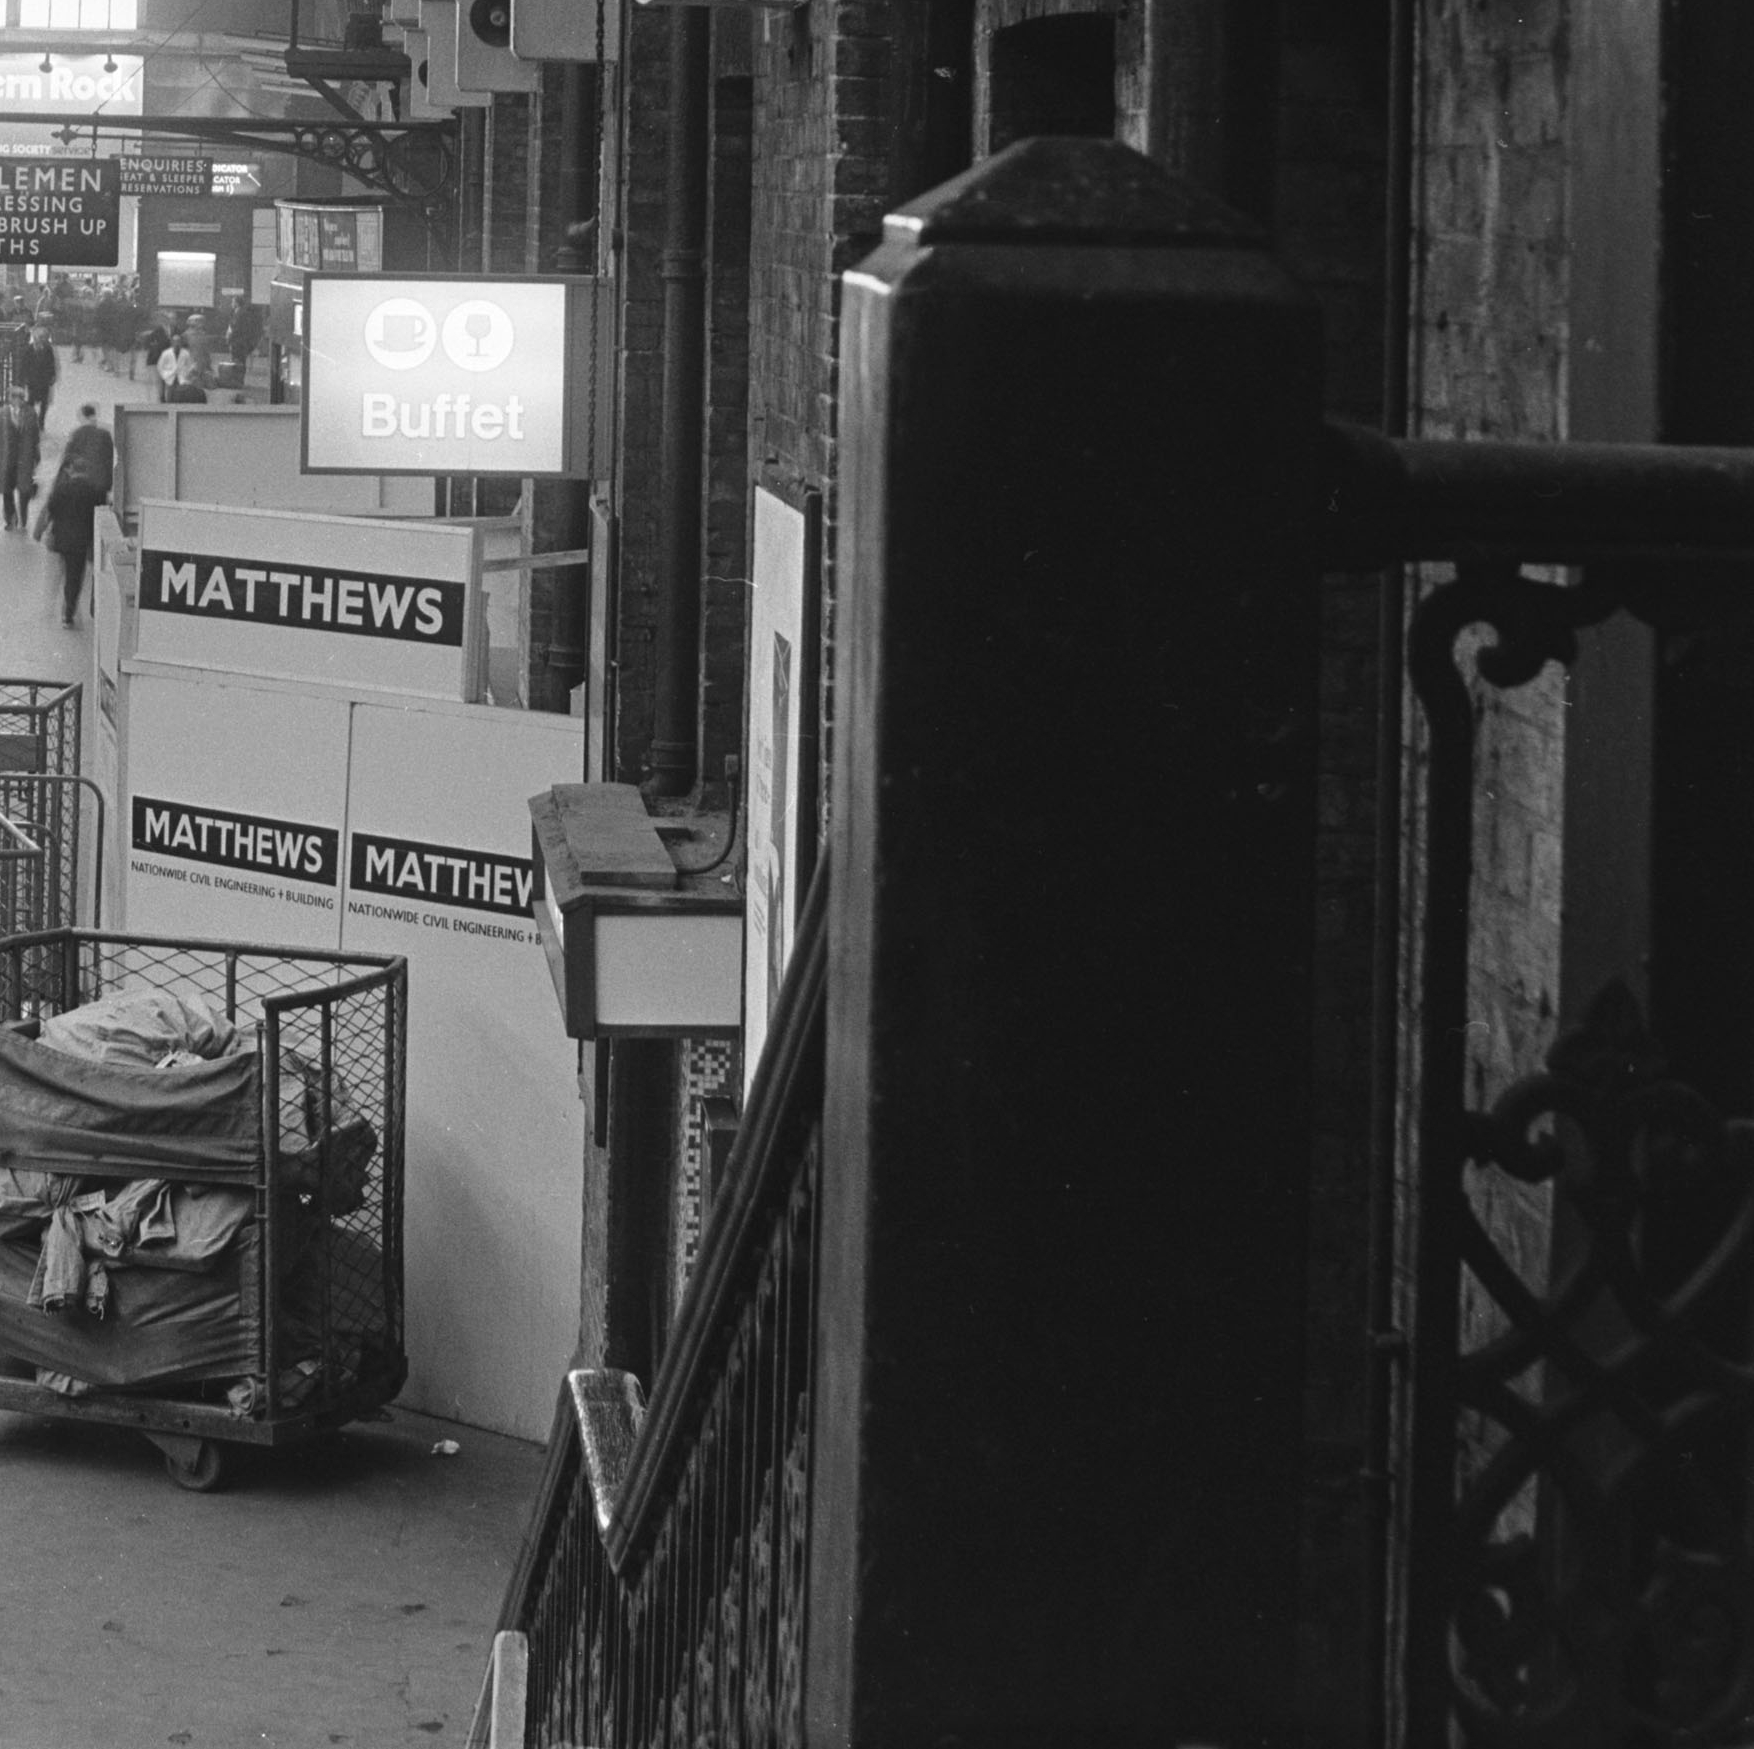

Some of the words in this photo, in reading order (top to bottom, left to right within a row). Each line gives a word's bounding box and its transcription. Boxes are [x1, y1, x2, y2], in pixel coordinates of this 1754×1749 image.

[50, 67, 136, 101] Rock
[12, 144, 51, 154] SOCIETY
[120, 158, 204, 172] ENQUIRIES
[120, 172, 142, 181] EAT
[162, 173, 204, 183] SLEEPER
[121, 183, 200, 194] RESERVATIONS
[80, 219, 106, 235] UP
[361, 393, 524, 440] Buffet
[161, 560, 443, 635] MATTHEWS
[145, 807, 322, 874] MATTHEWS
[131, 860, 188, 882] NATIONWIDE
[189, 872, 211, 886] CIVIL
[214, 877, 275, 898] ENGINEERING
[286, 890, 334, 910] BUILDING
[348, 901, 419, 925] NATIONWIDE
[423, 913, 449, 930] CIVIL
[453, 918, 525, 943] ENGINEERING
